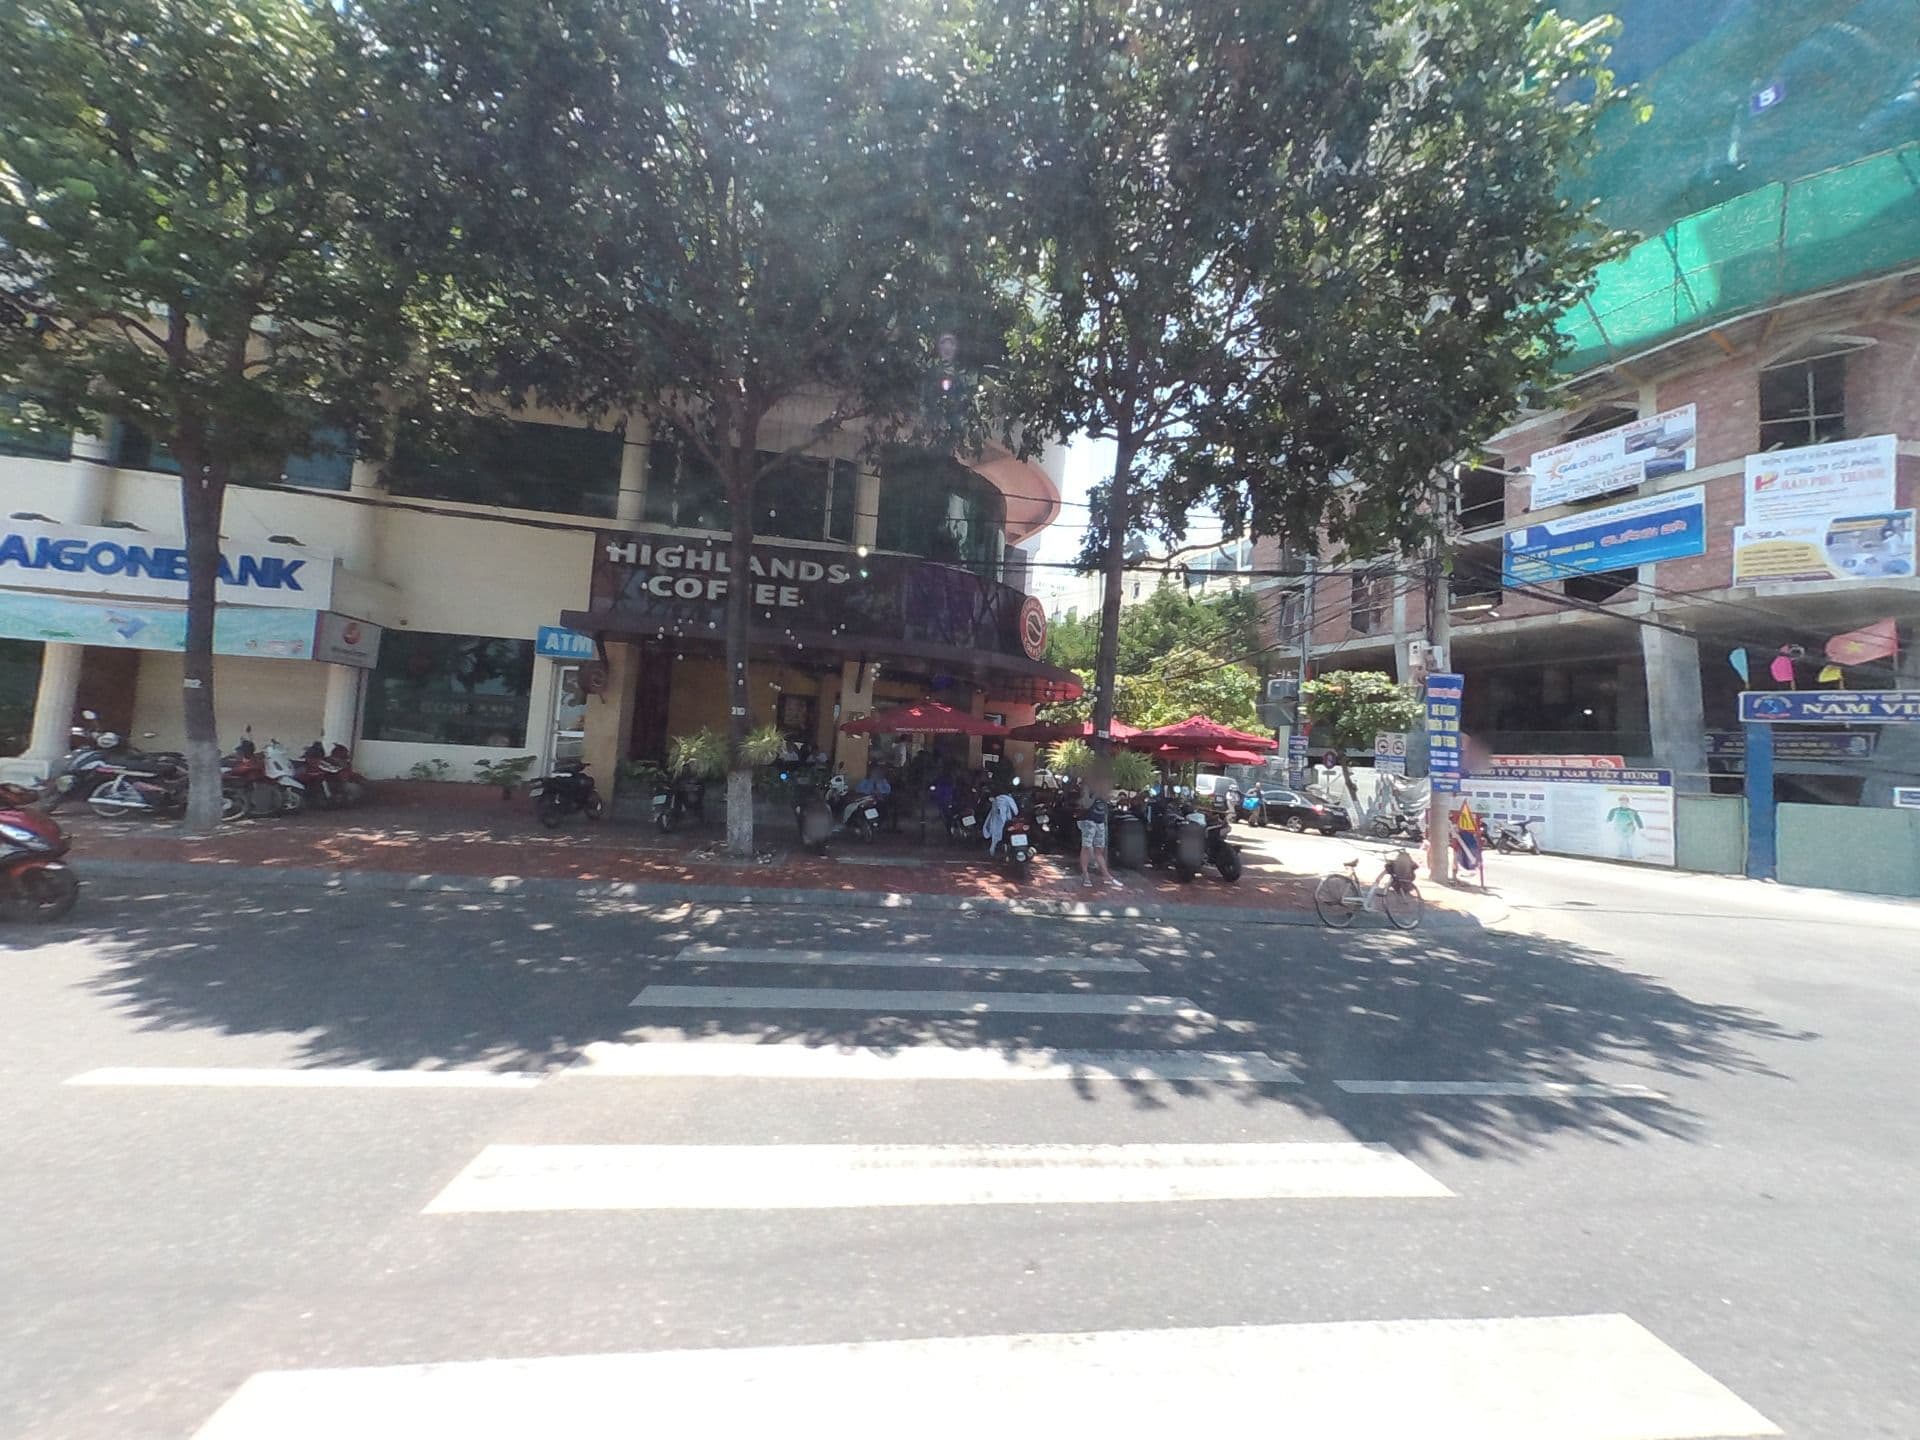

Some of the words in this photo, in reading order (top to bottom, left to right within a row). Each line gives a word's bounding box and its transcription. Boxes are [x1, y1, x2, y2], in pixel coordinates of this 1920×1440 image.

[608, 542, 850, 584] HIGHLANDS
[648, 575, 800, 609] COFEE
[545, 632, 592, 654] ATM
[1802, 702, 1873, 715] NAM
[1878, 702, 1920, 715] VI
